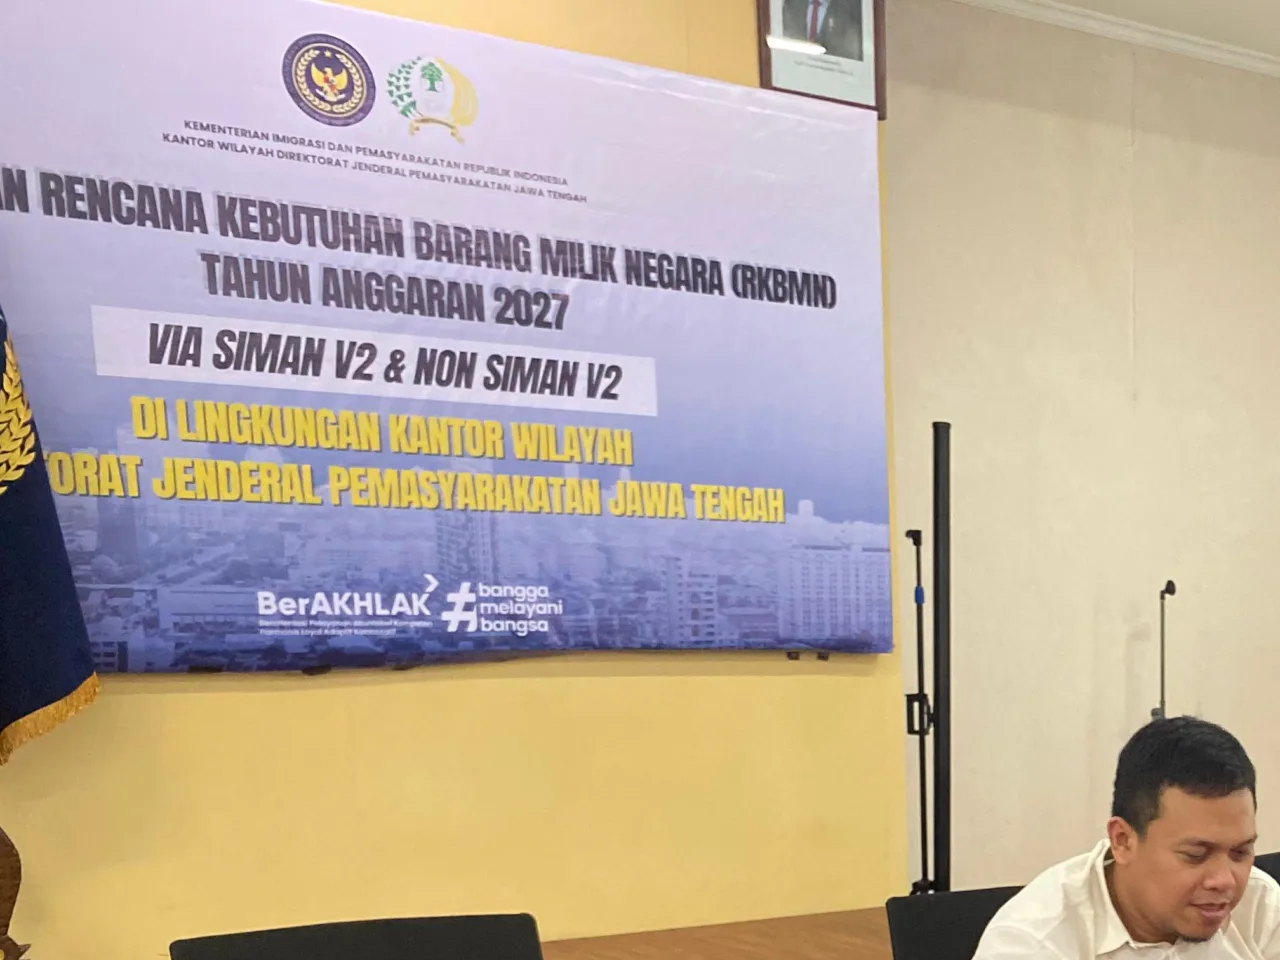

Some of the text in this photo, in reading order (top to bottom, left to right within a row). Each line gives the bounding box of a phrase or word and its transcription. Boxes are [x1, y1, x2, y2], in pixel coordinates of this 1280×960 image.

[162, 133, 587, 203] KANTOR WILAYAH DIREKTORAT JENDERAL PEMASYARAKATAN JAWA TENGAH
[184, 120, 568, 186] KEMENTERIAN IMIGRASI DAN PEMASYARAKATAN REPUBLIK INDONESIA
[40, 171, 208, 235] RENCANA
[216, 194, 402, 258] KEBUTUHAN
[413, 220, 530, 272] BARANG
[540, 237, 618, 284] MILIK
[624, 247, 724, 296] NEGARA
[732, 263, 837, 309] (RKBMN)
[201, 253, 569, 331] TAHUN ANGGARAN 2027
[148, 323, 623, 400] VIA SIMAN V2 & NON SIMAN V2
[130, 396, 634, 466] DI LINGKUNGAN KANTOR WILAYAH
[43, 450, 785, 524] ORAT JENDERAL PEMASYARAKATAN JAWA TENGAH
[257, 591, 431, 616] BerAKHLAK
[479, 582, 549, 599] bangga
[480, 599, 563, 617] melayani
[480, 618, 549, 636] bangsa
